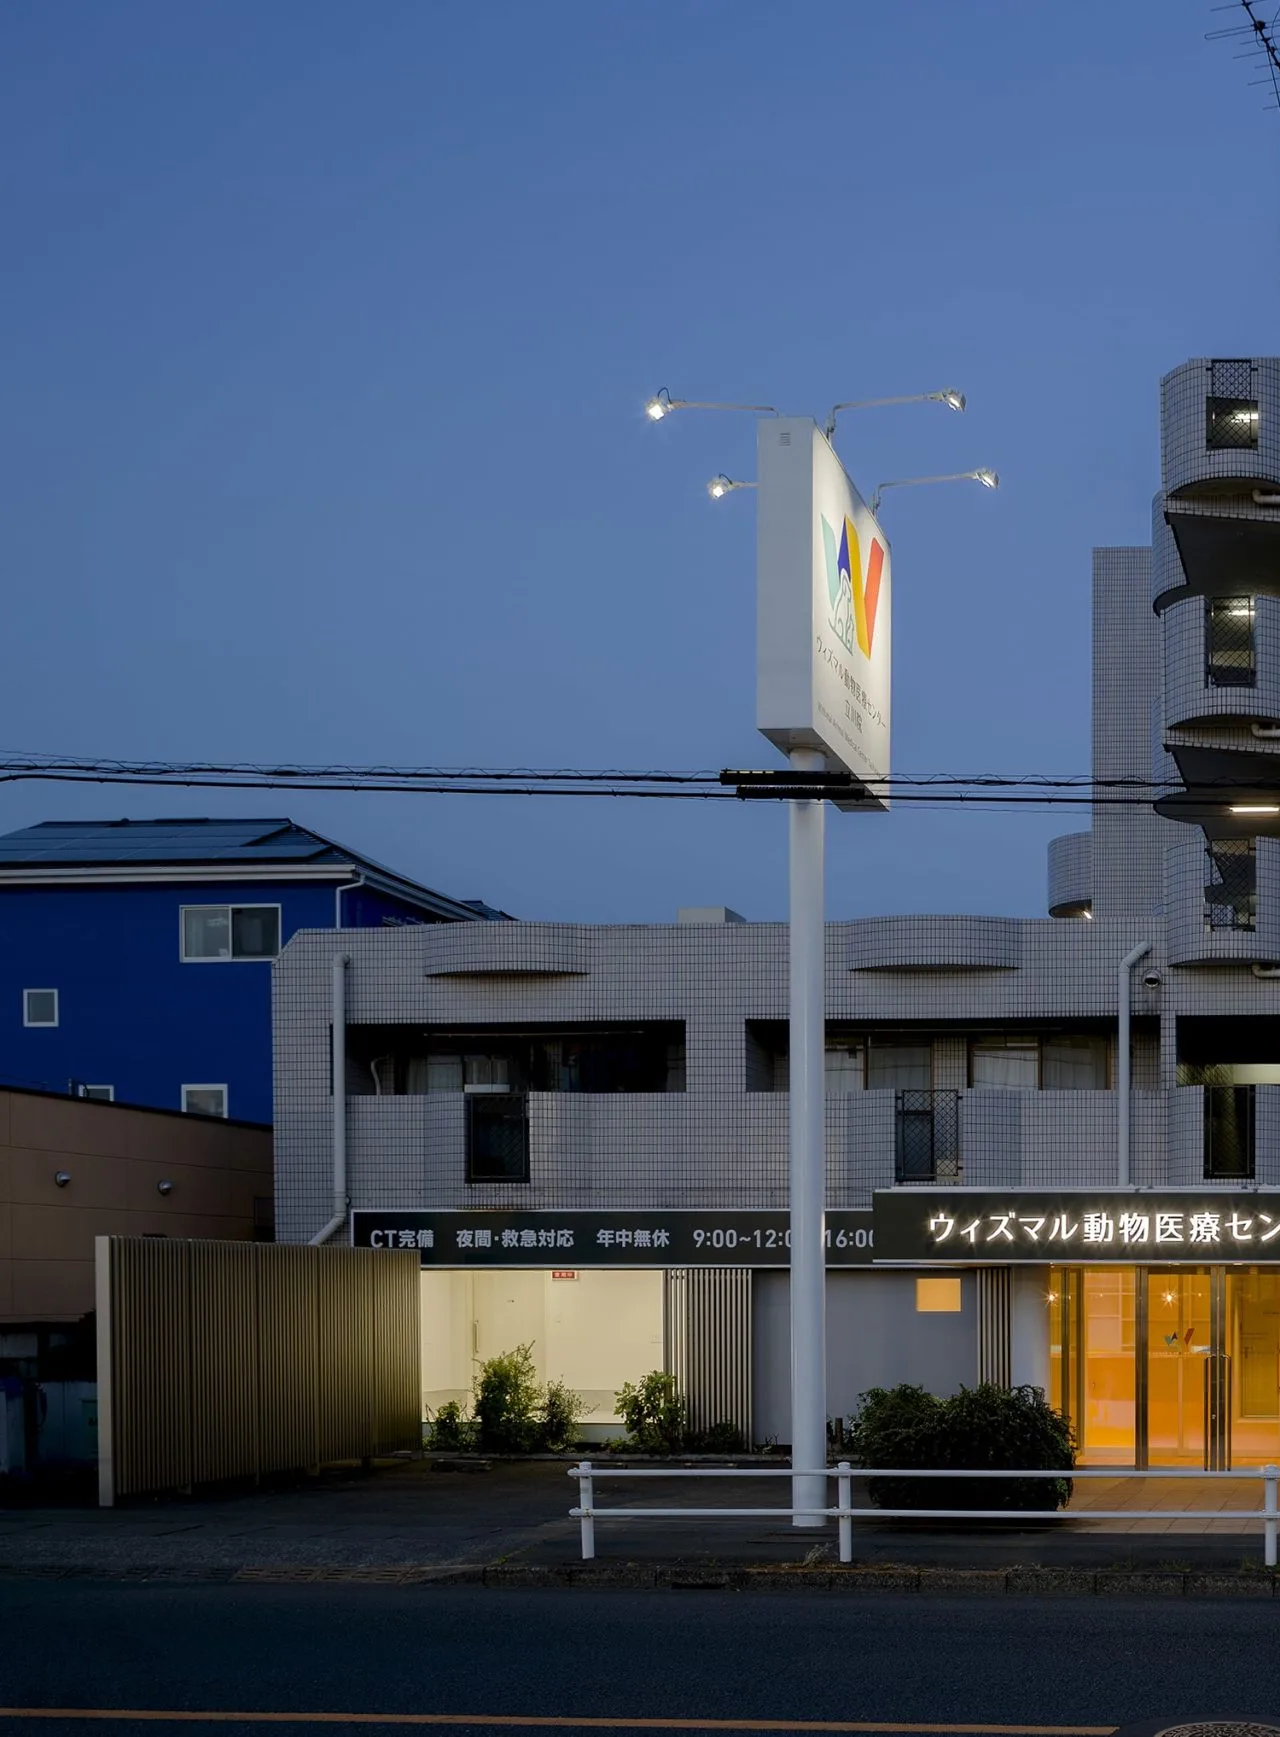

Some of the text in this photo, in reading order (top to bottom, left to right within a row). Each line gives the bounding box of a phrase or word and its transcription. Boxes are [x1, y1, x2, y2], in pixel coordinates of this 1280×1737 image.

[817, 636, 886, 729] ウィズマル動物医療センター
[844, 699, 863, 734] 立川院
[370, 1229, 434, 1249] CT完備
[596, 1229, 671, 1249] 年中無休
